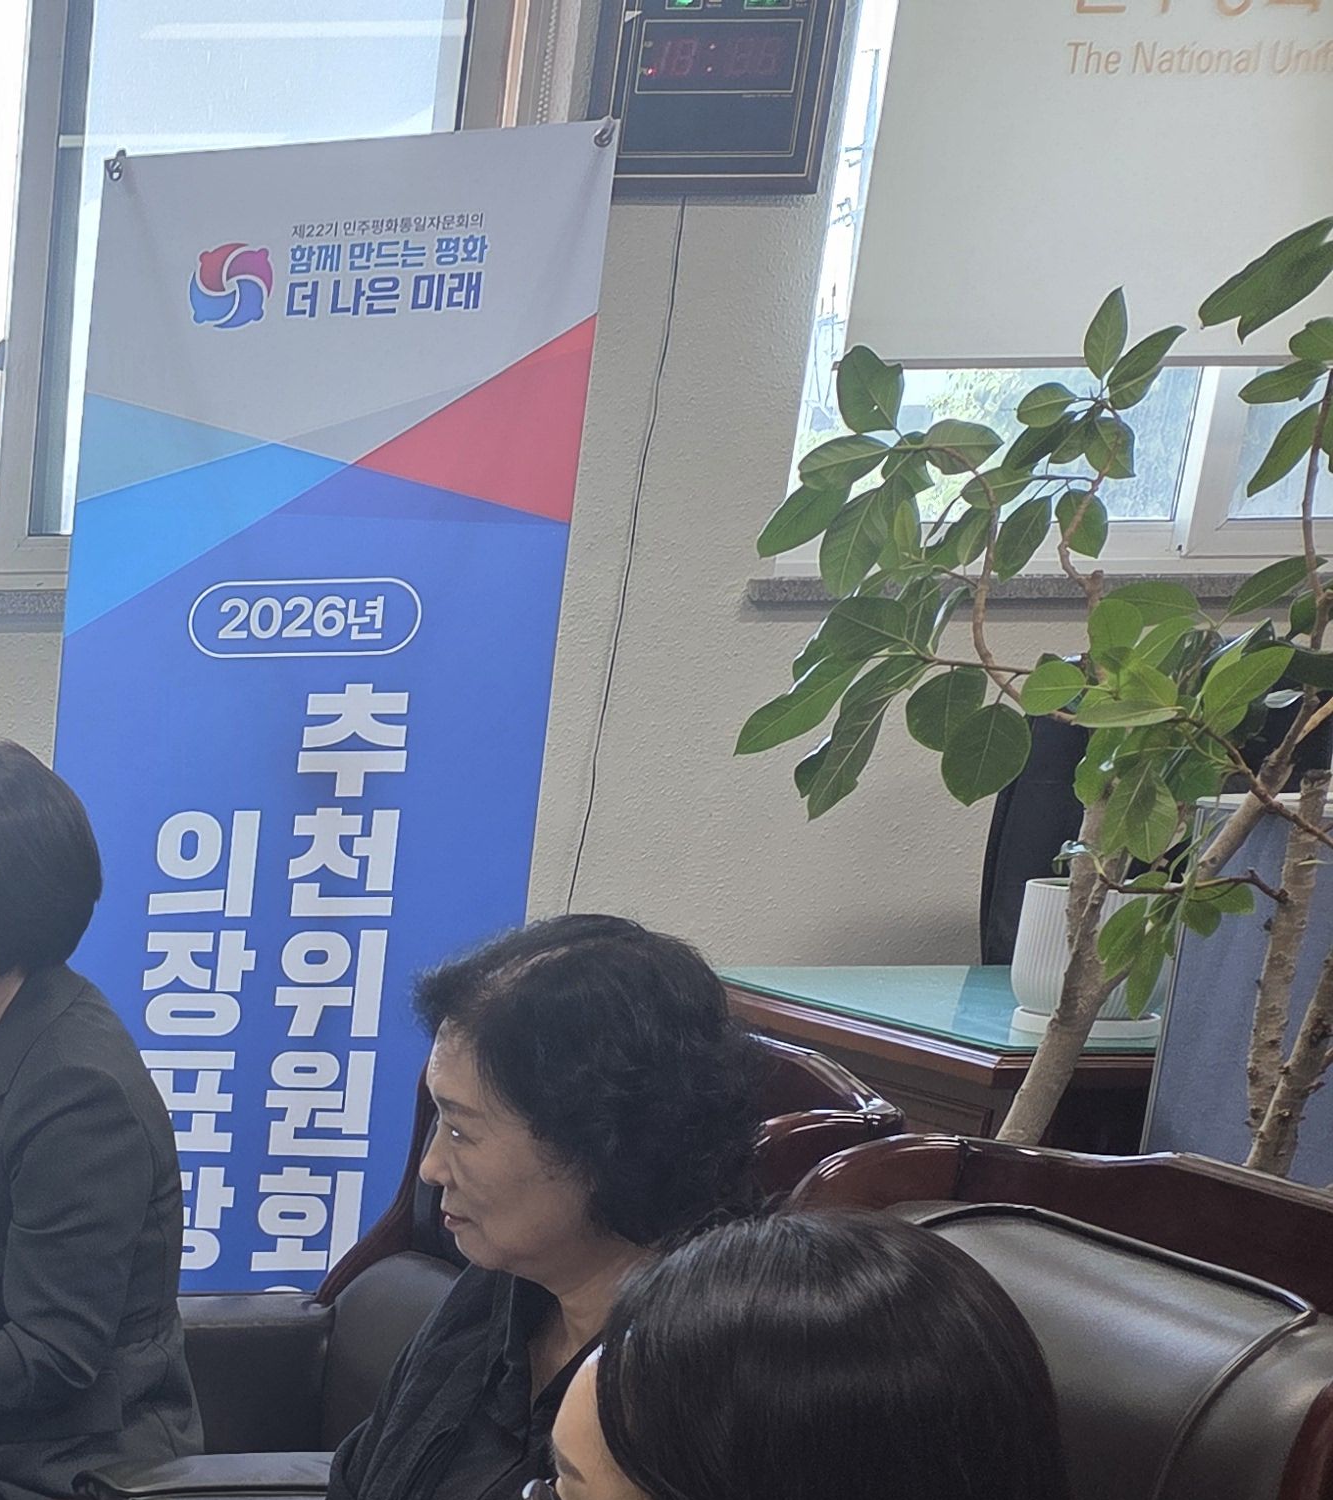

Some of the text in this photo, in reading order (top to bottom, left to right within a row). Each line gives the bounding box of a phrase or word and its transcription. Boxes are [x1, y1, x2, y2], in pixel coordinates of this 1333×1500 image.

[1067, 41, 1122, 75] The
[1132, 40, 1261, 75] National
[291, 212, 484, 239] 제22기 민주평화통일자문회의
[290, 234, 489, 275] 함께 만드는 평화
[286, 271, 483, 318] 더 나은 미래
[217, 595, 385, 640] 2026년
[249, 682, 410, 1292] 추천위원회
